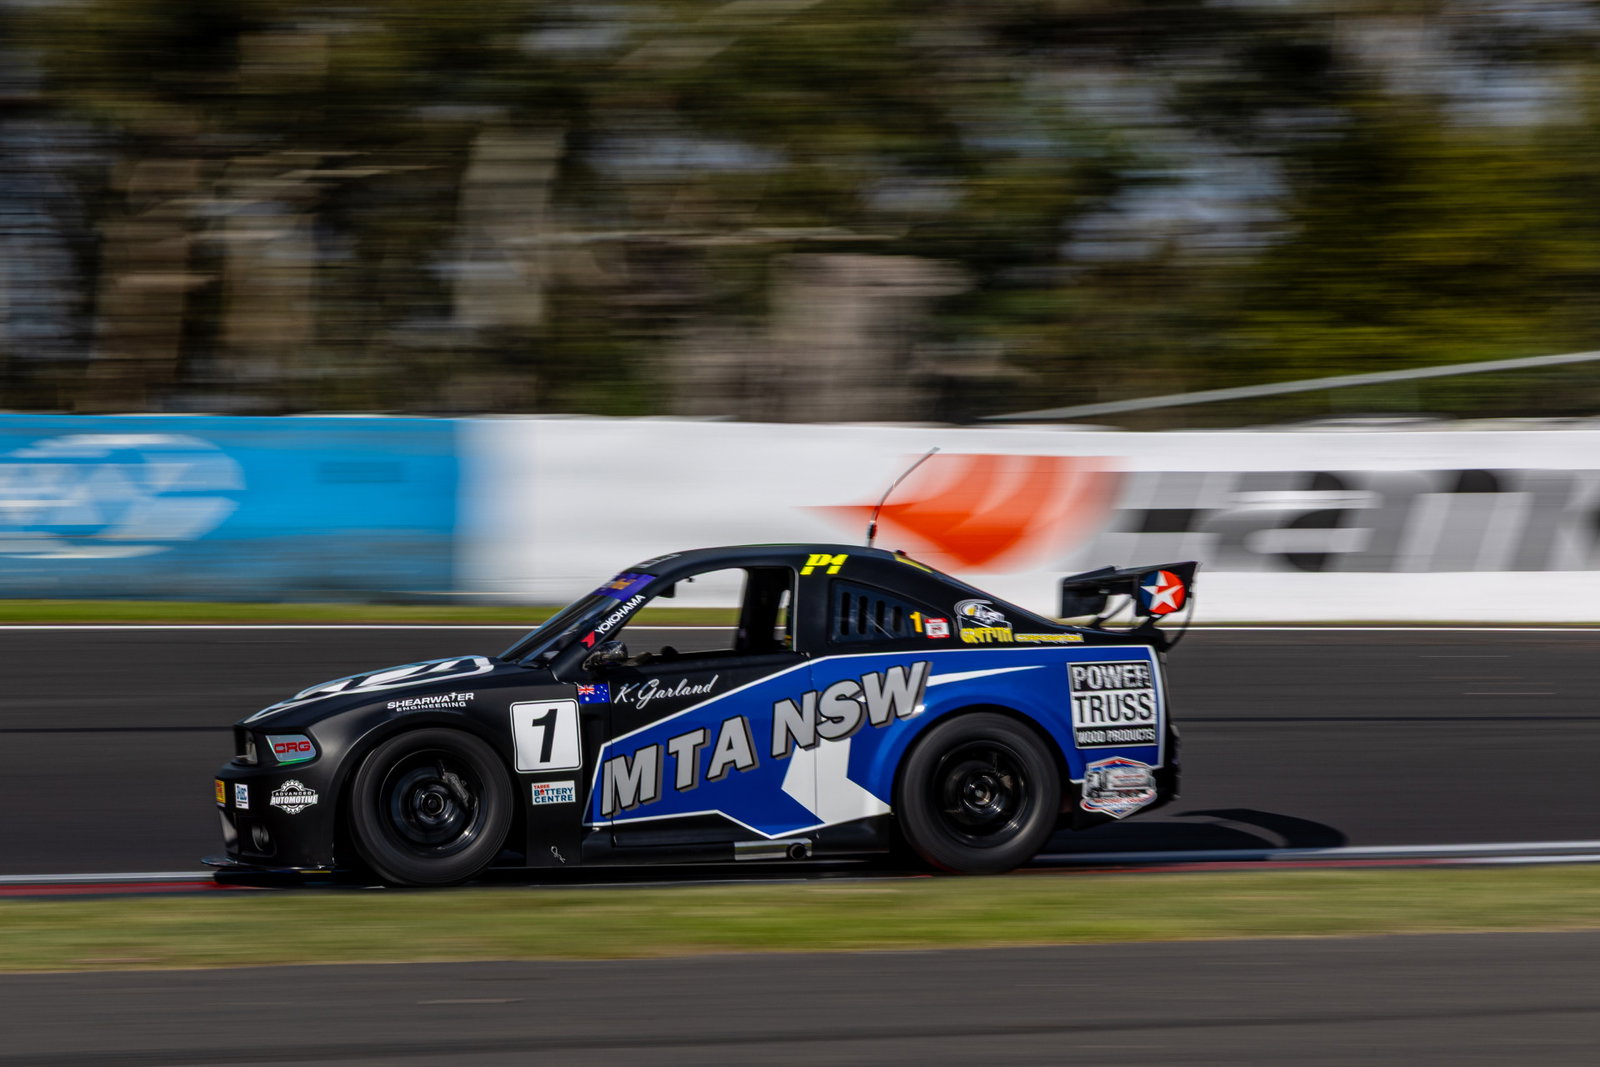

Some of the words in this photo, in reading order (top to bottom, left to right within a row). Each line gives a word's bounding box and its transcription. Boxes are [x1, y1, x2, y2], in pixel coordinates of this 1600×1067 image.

[595, 594, 646, 635] YOKOHAMA
[909, 611, 923, 633] 1
[387, 692, 475, 710] SHEARWATER
[635, 674, 719, 710] Garland
[396, 701, 467, 712] ENGINEERING
[1074, 693, 1152, 723] TRUSS
[532, 709, 558, 763] 1
[602, 715, 760, 818] MTA
[771, 661, 932, 760] NSW
[1077, 731, 1105, 743] WOOD
[1107, 728, 1155, 743] PRODUCTS
[270, 795, 318, 805] AUTOMOTIVE
[535, 795, 573, 803] CENTRE
